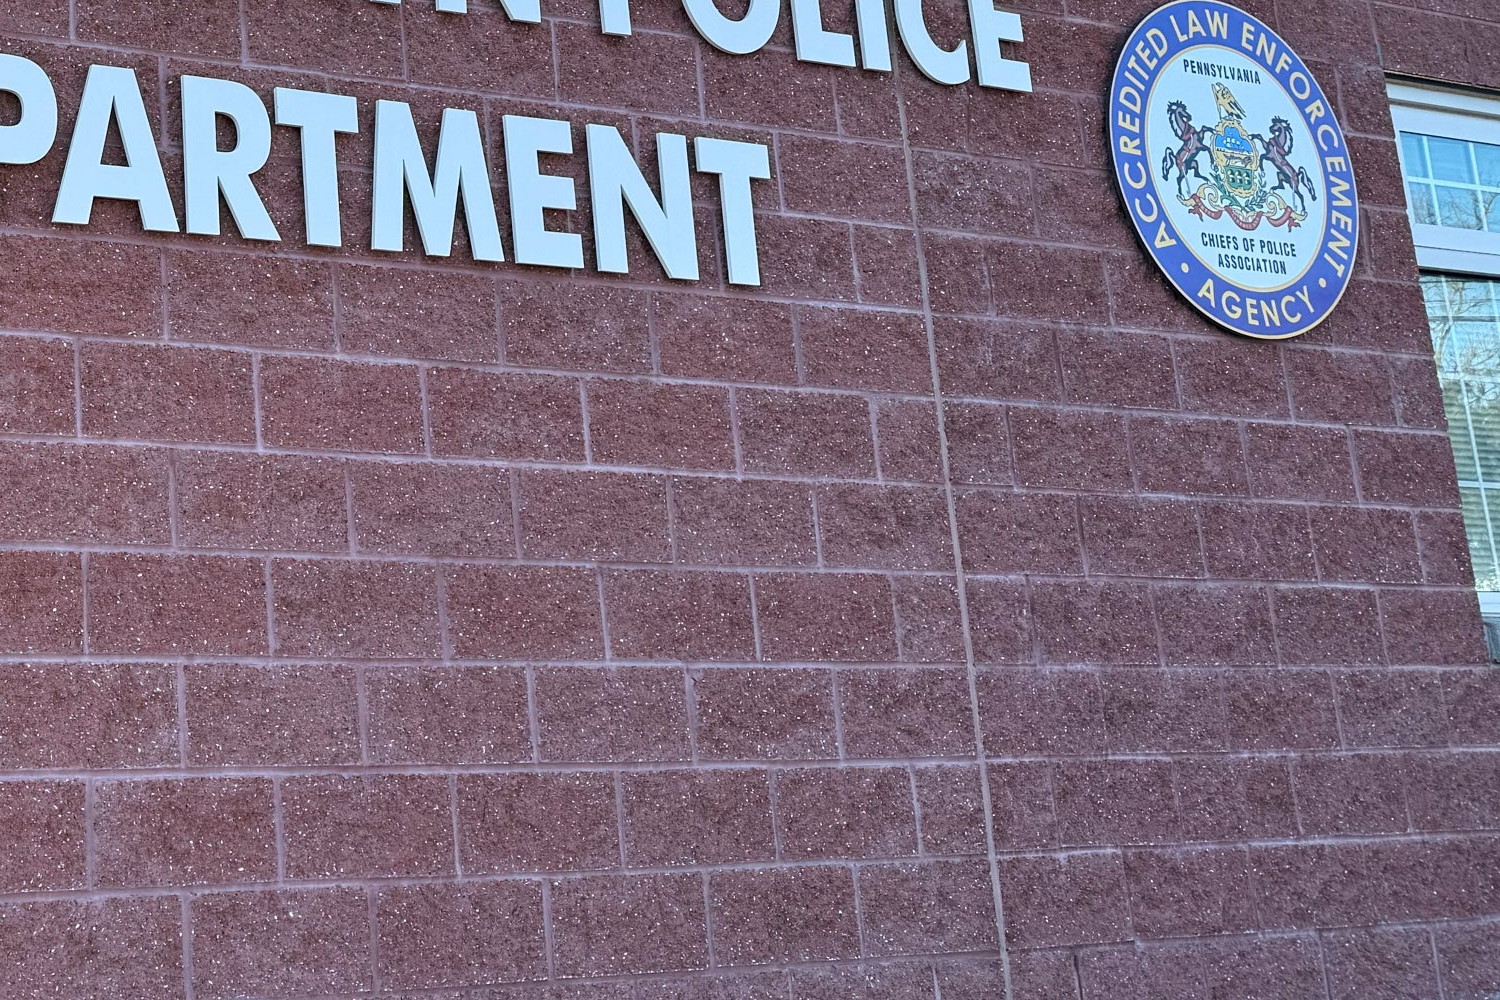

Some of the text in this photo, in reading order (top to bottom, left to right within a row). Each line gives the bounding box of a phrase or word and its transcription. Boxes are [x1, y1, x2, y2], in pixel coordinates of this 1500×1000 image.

[1183, 58, 1262, 85] PENNSYLVANIA
[1118, 8, 1354, 279] ACCREDITED LAW ENFORCEMENT
[1201, 231, 1298, 258] CHIEFS OF POLICE
[1218, 252, 1287, 275] ASSOCIATION
[1198, 278, 1316, 328] AGENCY
